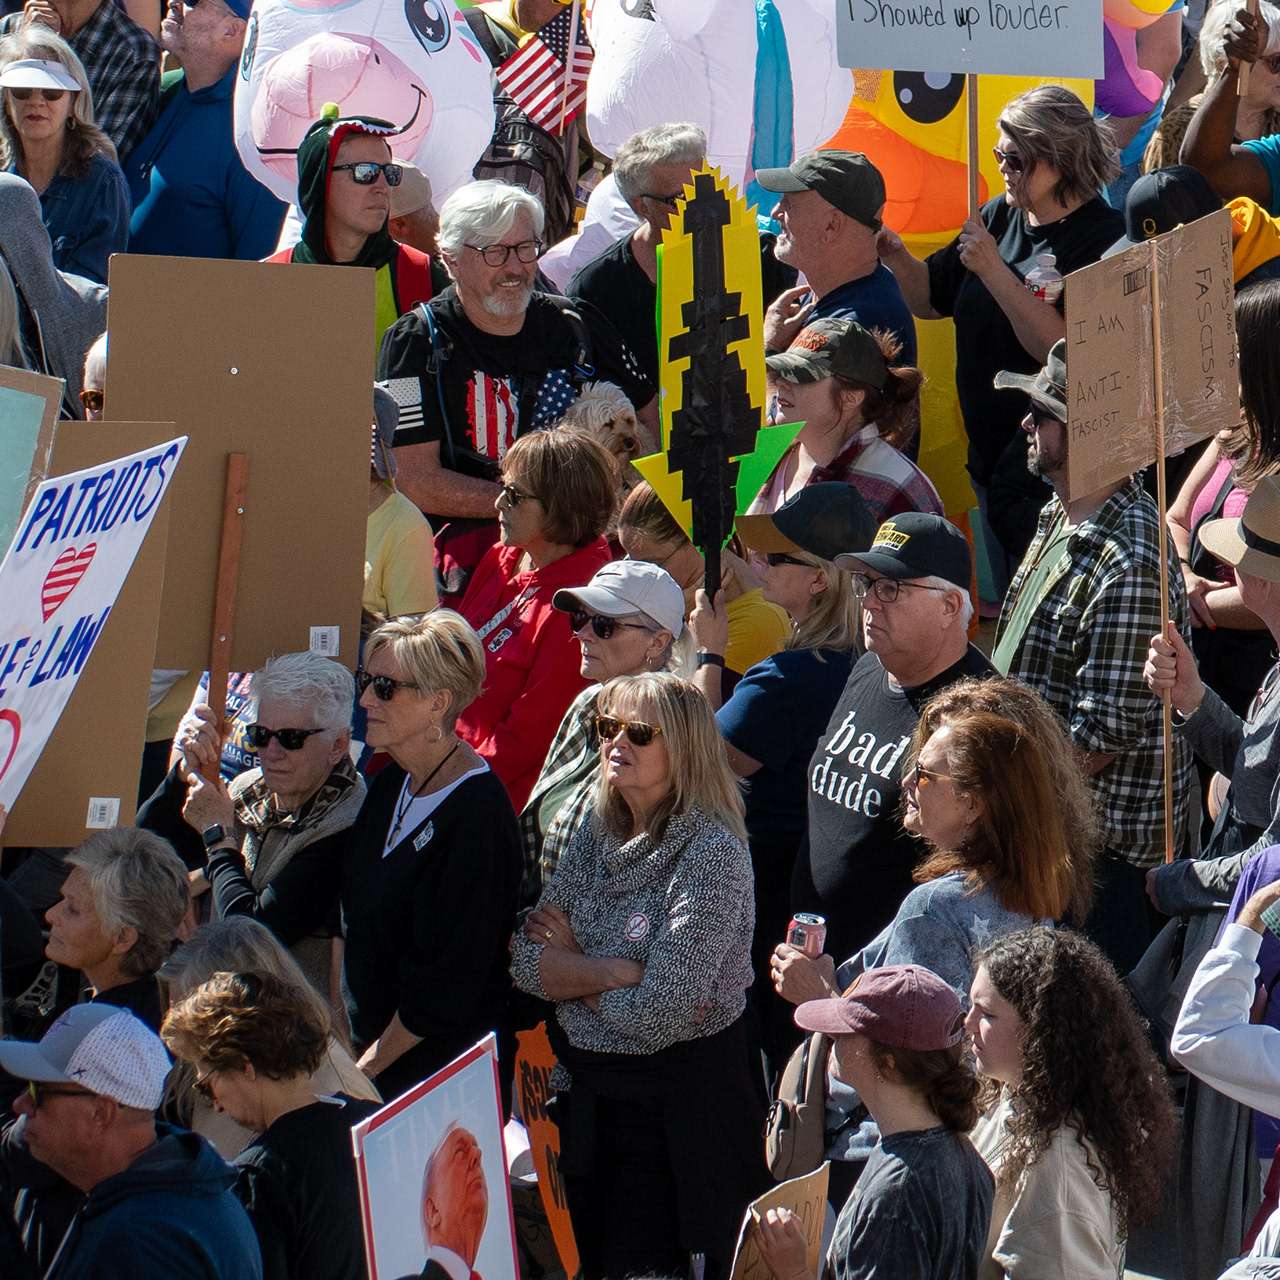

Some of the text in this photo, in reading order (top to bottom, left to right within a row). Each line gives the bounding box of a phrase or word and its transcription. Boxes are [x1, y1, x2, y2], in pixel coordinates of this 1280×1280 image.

[954, 4, 979, 33] up
[1075, 312, 1125, 346] I AM
[1194, 265, 1215, 401] FASCISM
[16, 441, 181, 554] PATRIOTS
[27, 604, 113, 689] LAW
[825, 710, 911, 779] bad
[811, 756, 882, 819] dude
